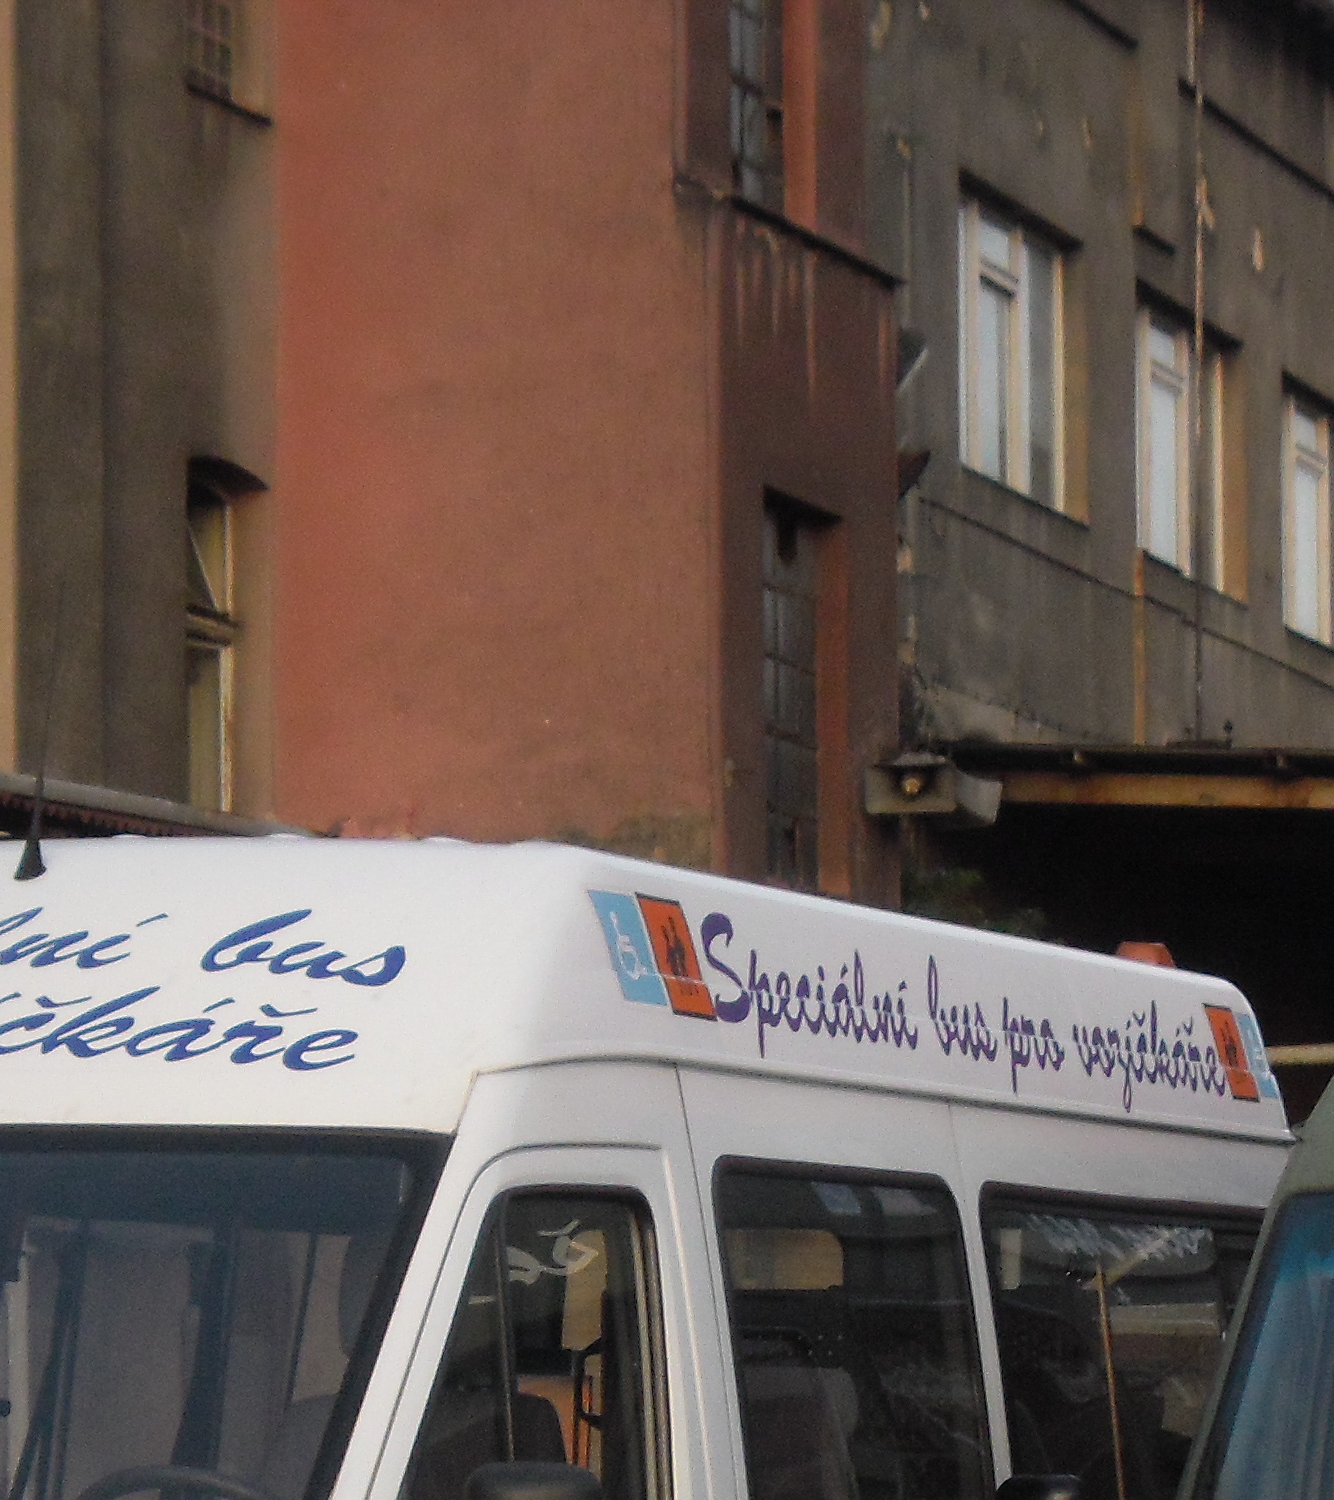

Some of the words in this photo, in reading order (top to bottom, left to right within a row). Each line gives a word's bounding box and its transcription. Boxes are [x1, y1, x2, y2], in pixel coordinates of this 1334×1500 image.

[200, 908, 408, 988] bus
[700, 912, 918, 1058] Speciální
[927, 955, 998, 1061] bus
[1003, 997, 1064, 1095] pro
[1072, 1000, 1227, 1113] vozíčkáře
